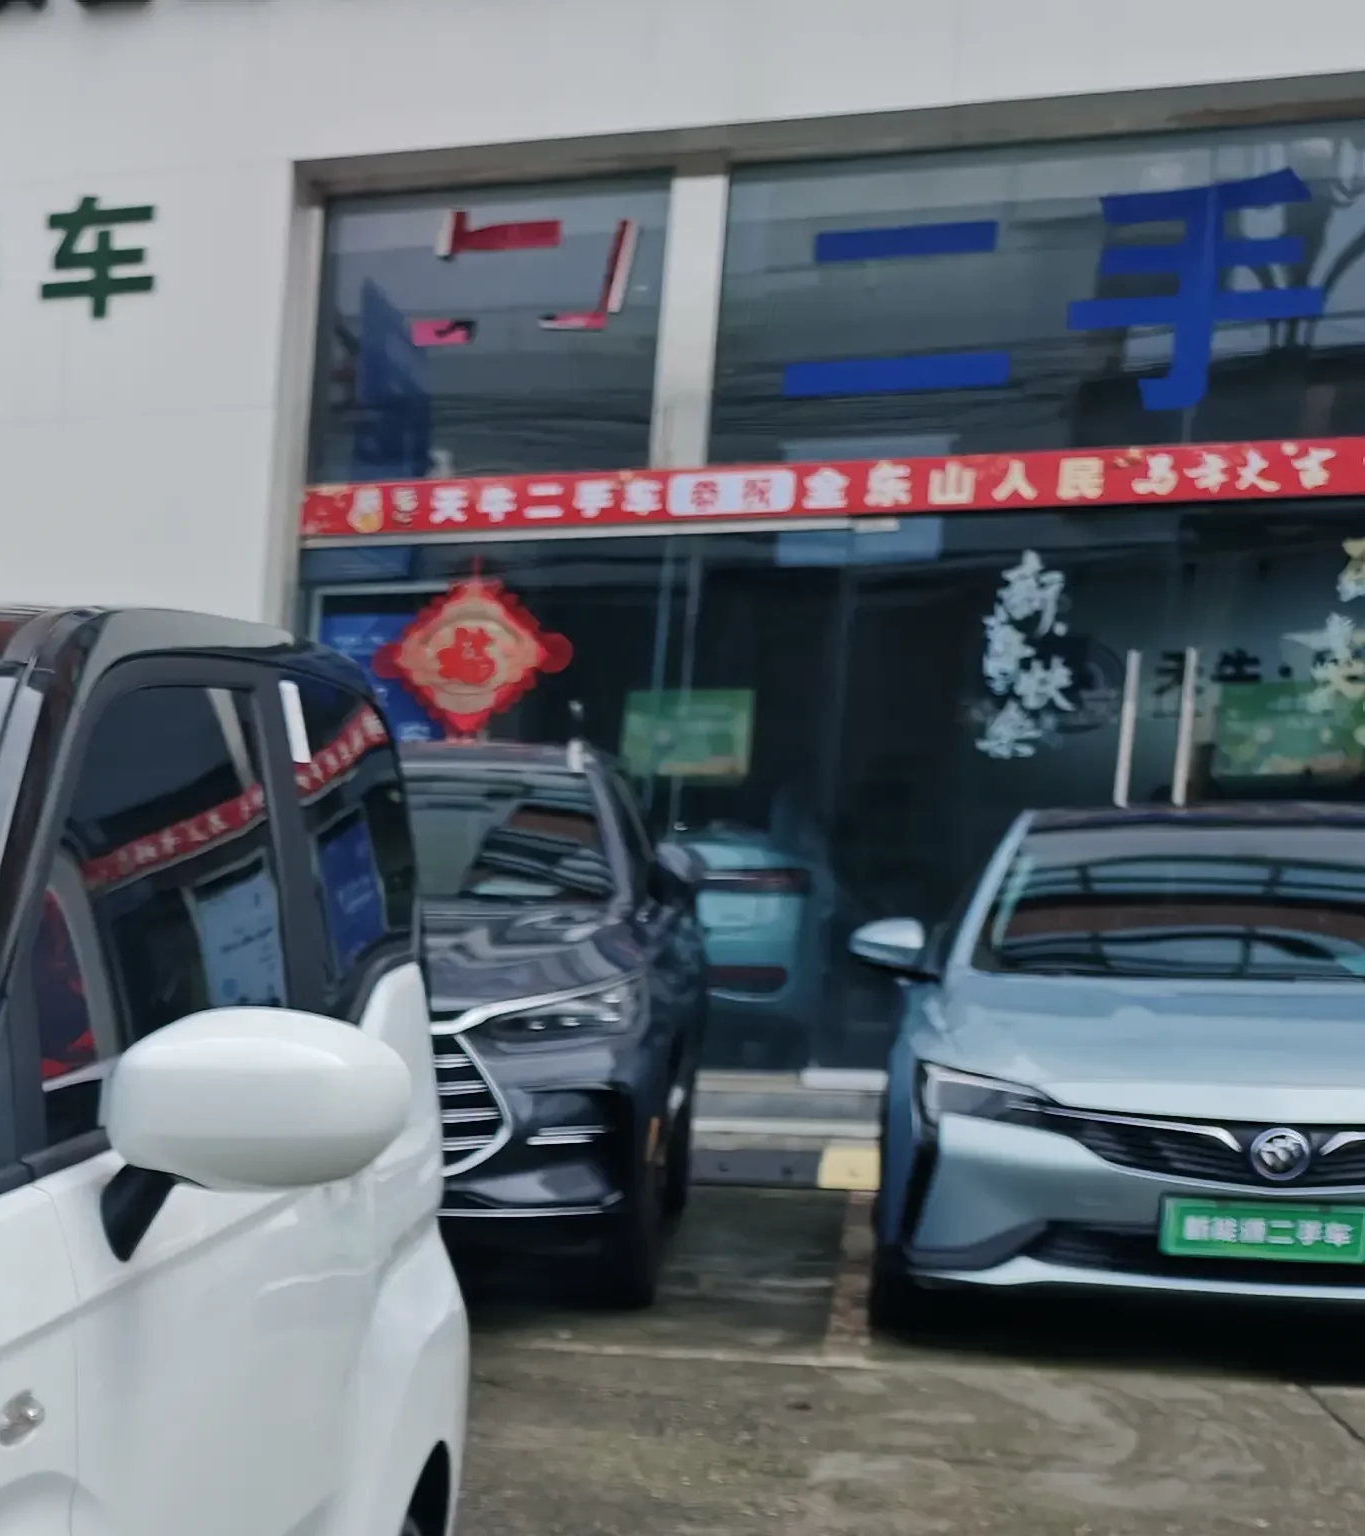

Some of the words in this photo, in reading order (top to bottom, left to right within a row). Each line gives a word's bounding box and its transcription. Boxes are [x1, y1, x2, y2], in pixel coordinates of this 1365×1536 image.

[1183, 1214, 1354, 1247] 新能源二手车
